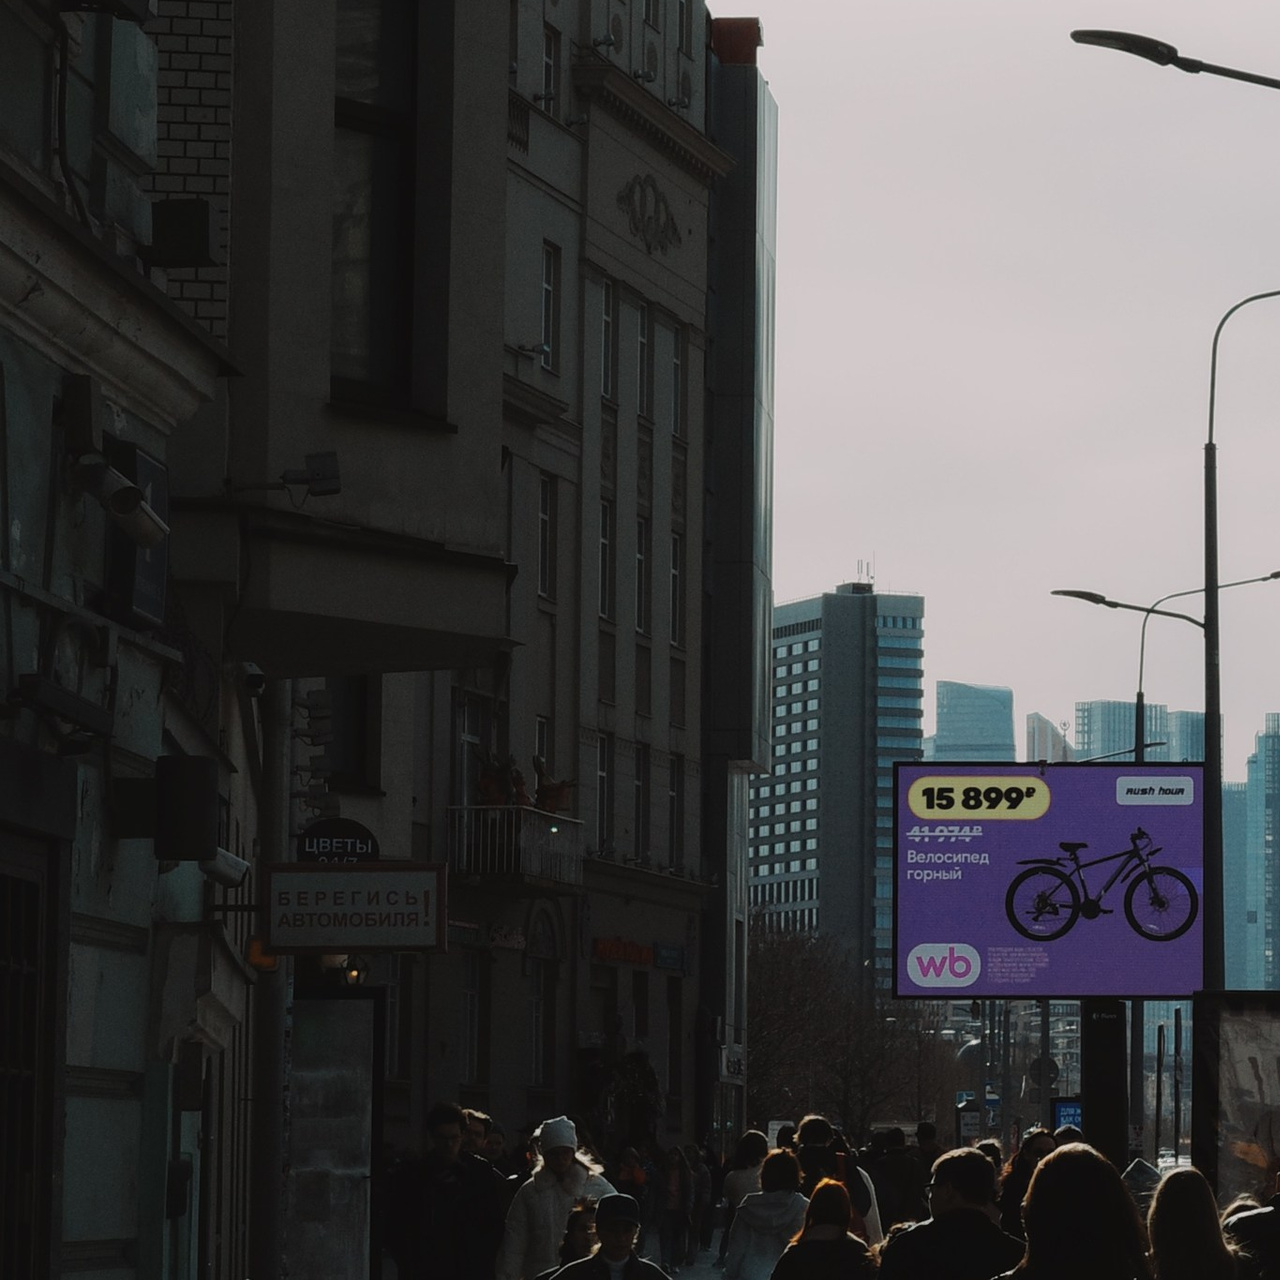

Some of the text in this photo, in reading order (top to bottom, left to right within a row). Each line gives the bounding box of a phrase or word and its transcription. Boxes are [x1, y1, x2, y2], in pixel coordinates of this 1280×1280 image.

[922, 787, 955, 810] 15
[304, 837, 373, 854] ЦВЕТЫ
[907, 849, 990, 866] Велосипед
[907, 866, 962, 883] горный
[277, 890, 419, 907] БЕРЕГИСЬ
[277, 912, 420, 928] АВТОМОБИЛЯ
[915, 946, 972, 979] wb
